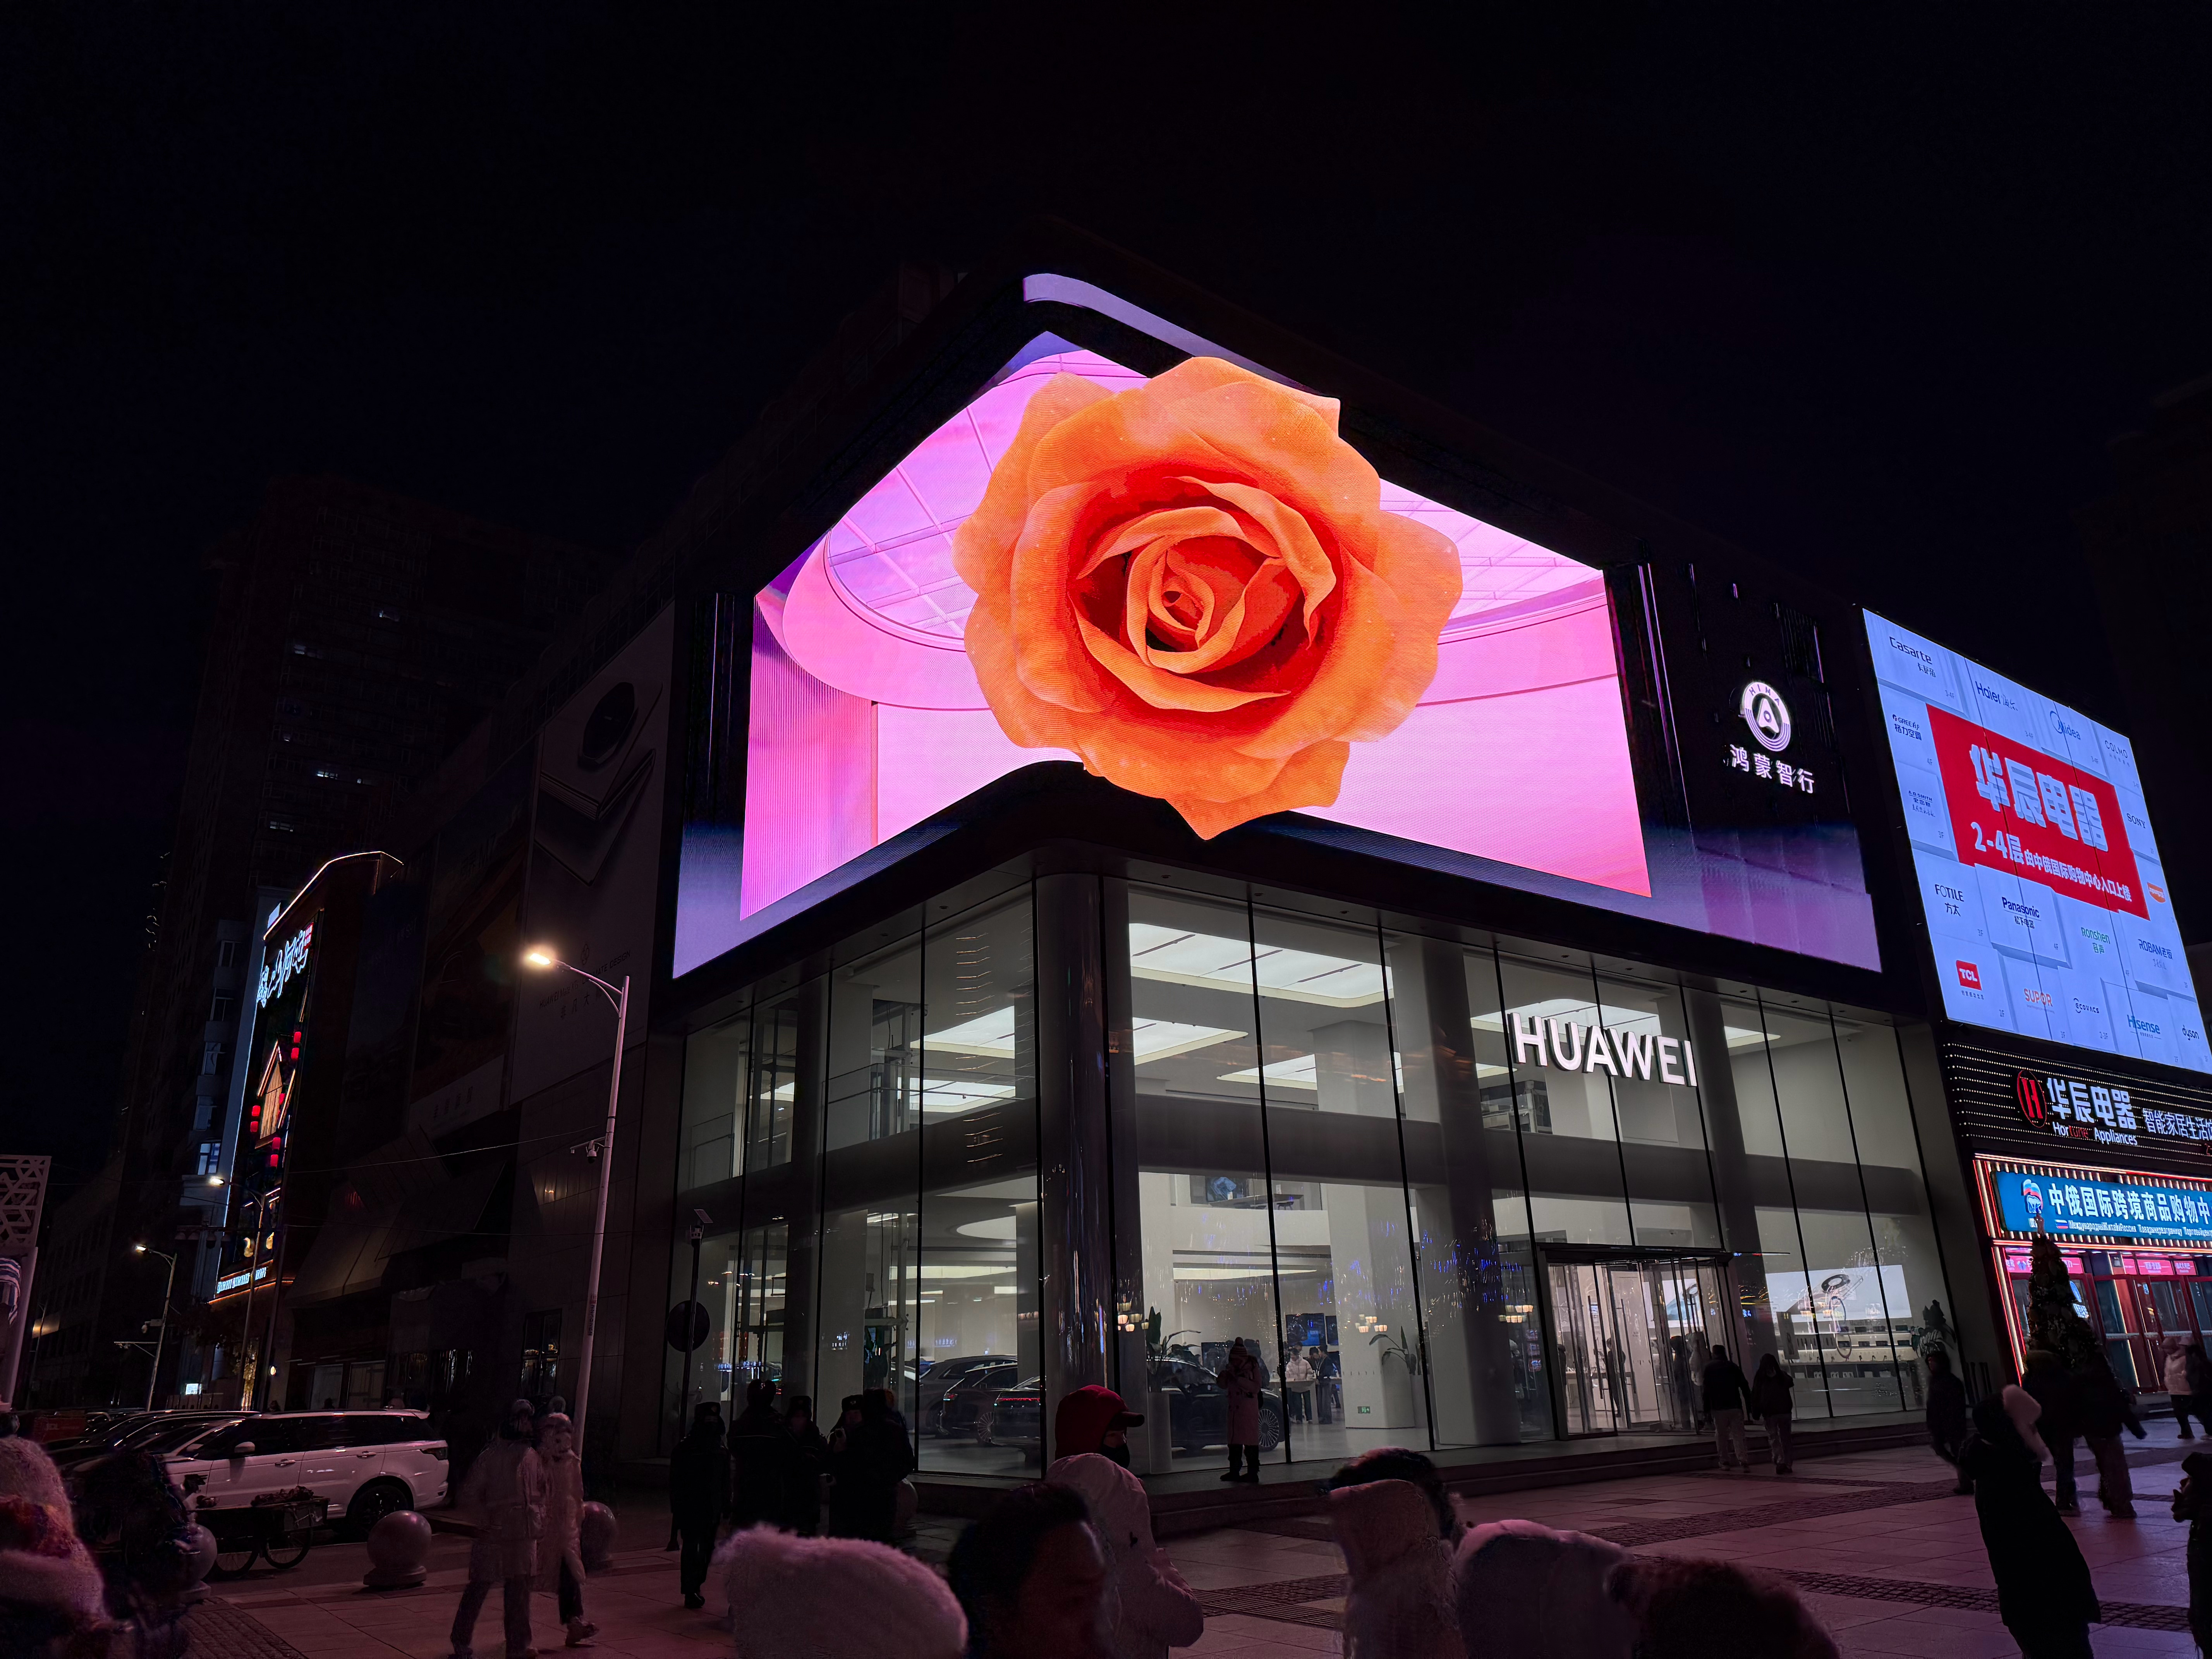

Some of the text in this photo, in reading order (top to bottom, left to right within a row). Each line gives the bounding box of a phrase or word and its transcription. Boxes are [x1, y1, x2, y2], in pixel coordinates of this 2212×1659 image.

[1889, 636, 1932, 665] Casarte
[1749, 684, 1780, 706] HIMA
[1975, 681, 2001, 704] Haier
[1894, 723, 1922, 741] 格力空调
[1898, 717, 1912, 727] GREE
[2053, 715, 2081, 740] Midea
[2105, 740, 2128, 759] COLMO
[1729, 744, 1814, 794] 鸿蒙智行
[1969, 744, 2109, 852] 华辰电器
[2126, 813, 2146, 829] SONY
[1970, 821, 2024, 864] 2-4层
[1935, 884, 1965, 902] FOTILE
[2001, 896, 2040, 918] Panasonic
[2081, 927, 2111, 944] Ronshen
[2092, 942, 2105, 954] 容声
[2138, 939, 2162, 956] ROBAM
[1959, 968, 1978, 982] TCL
[2024, 988, 2053, 1007] SUPOR
[2126, 1014, 2161, 1034] Hisense
[2182, 1024, 2200, 1041] dyson
[1508, 1012, 1697, 1087] HUAWEI
[2046, 1077, 2137, 1130] 华辰电器
[2052, 1121, 2138, 1146] Hortune Appliances
